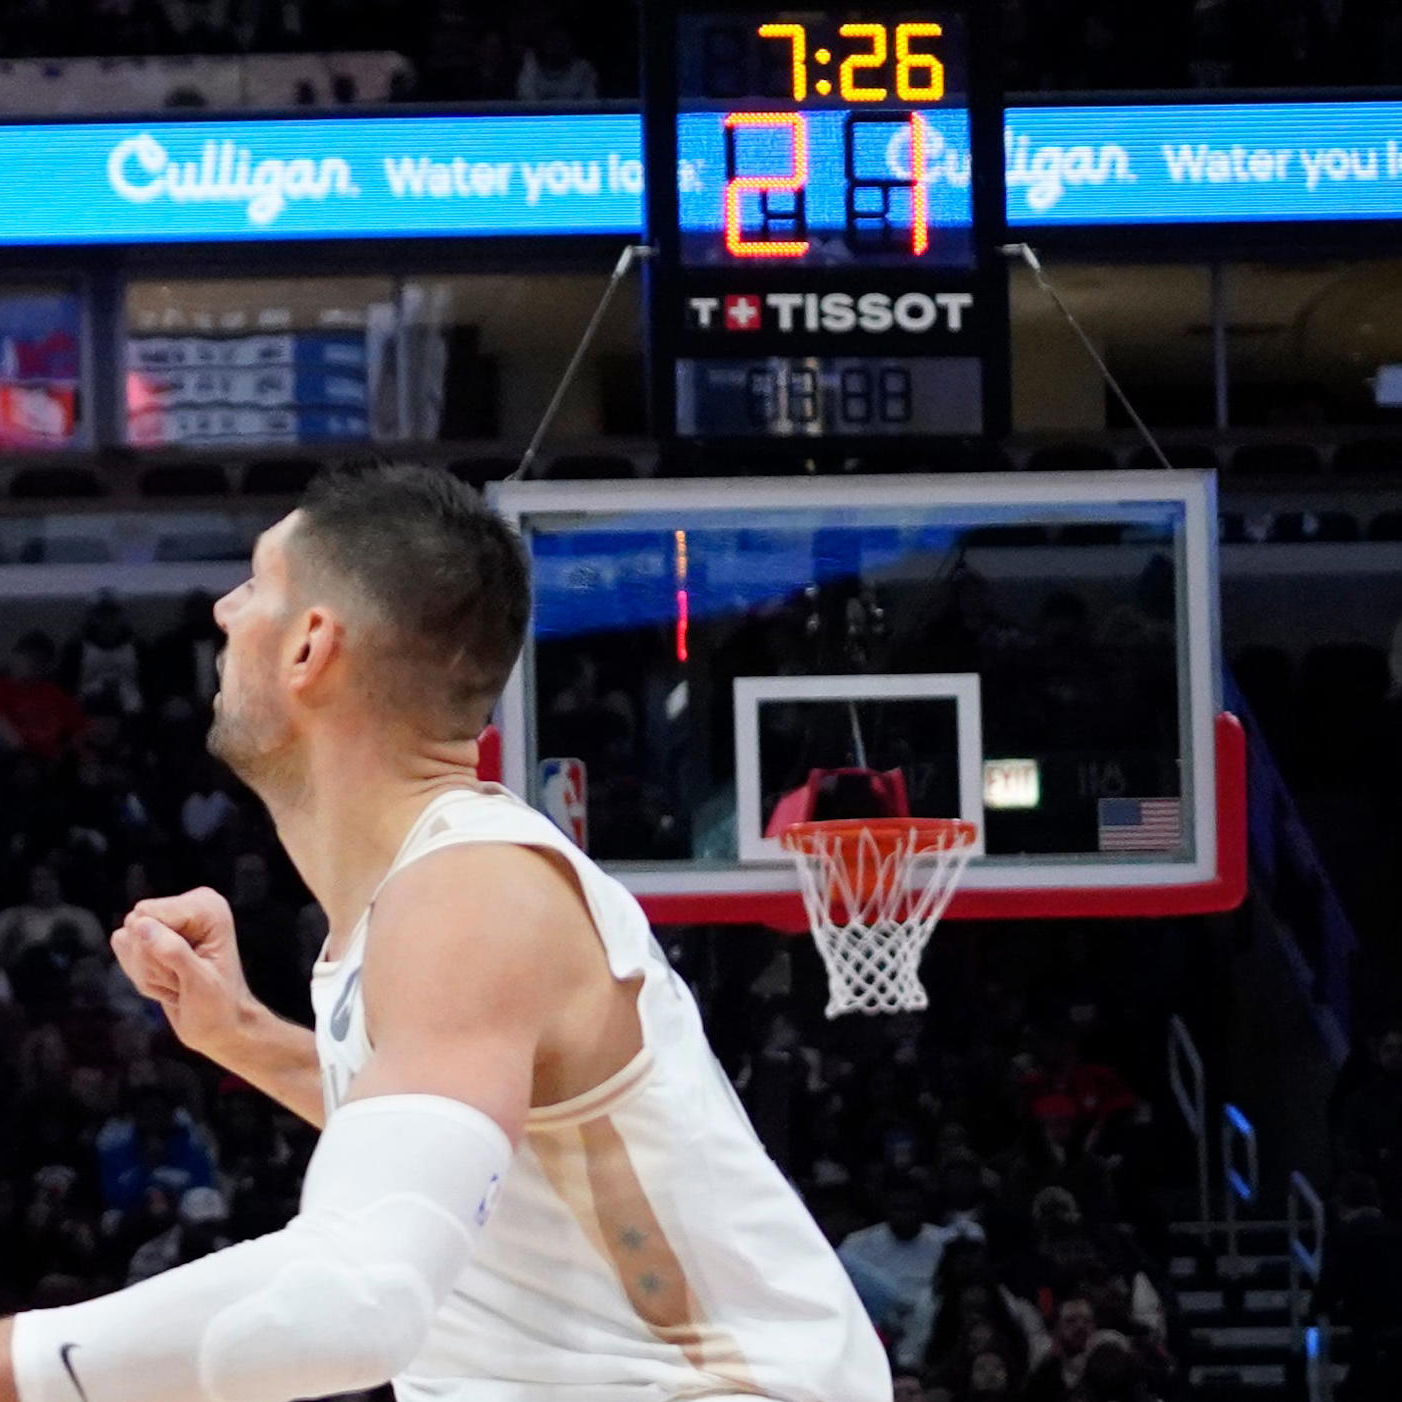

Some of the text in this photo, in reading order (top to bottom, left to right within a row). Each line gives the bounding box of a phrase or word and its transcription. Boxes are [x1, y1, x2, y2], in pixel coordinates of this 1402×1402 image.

[758, 22, 945, 102] 7:26
[383, 155, 512, 198] Water
[522, 158, 600, 206] you
[724, 111, 929, 258] 21
[1162, 141, 1294, 184] Water
[1299, 147, 1378, 193] you
[765, 292, 974, 333] TISSOT
